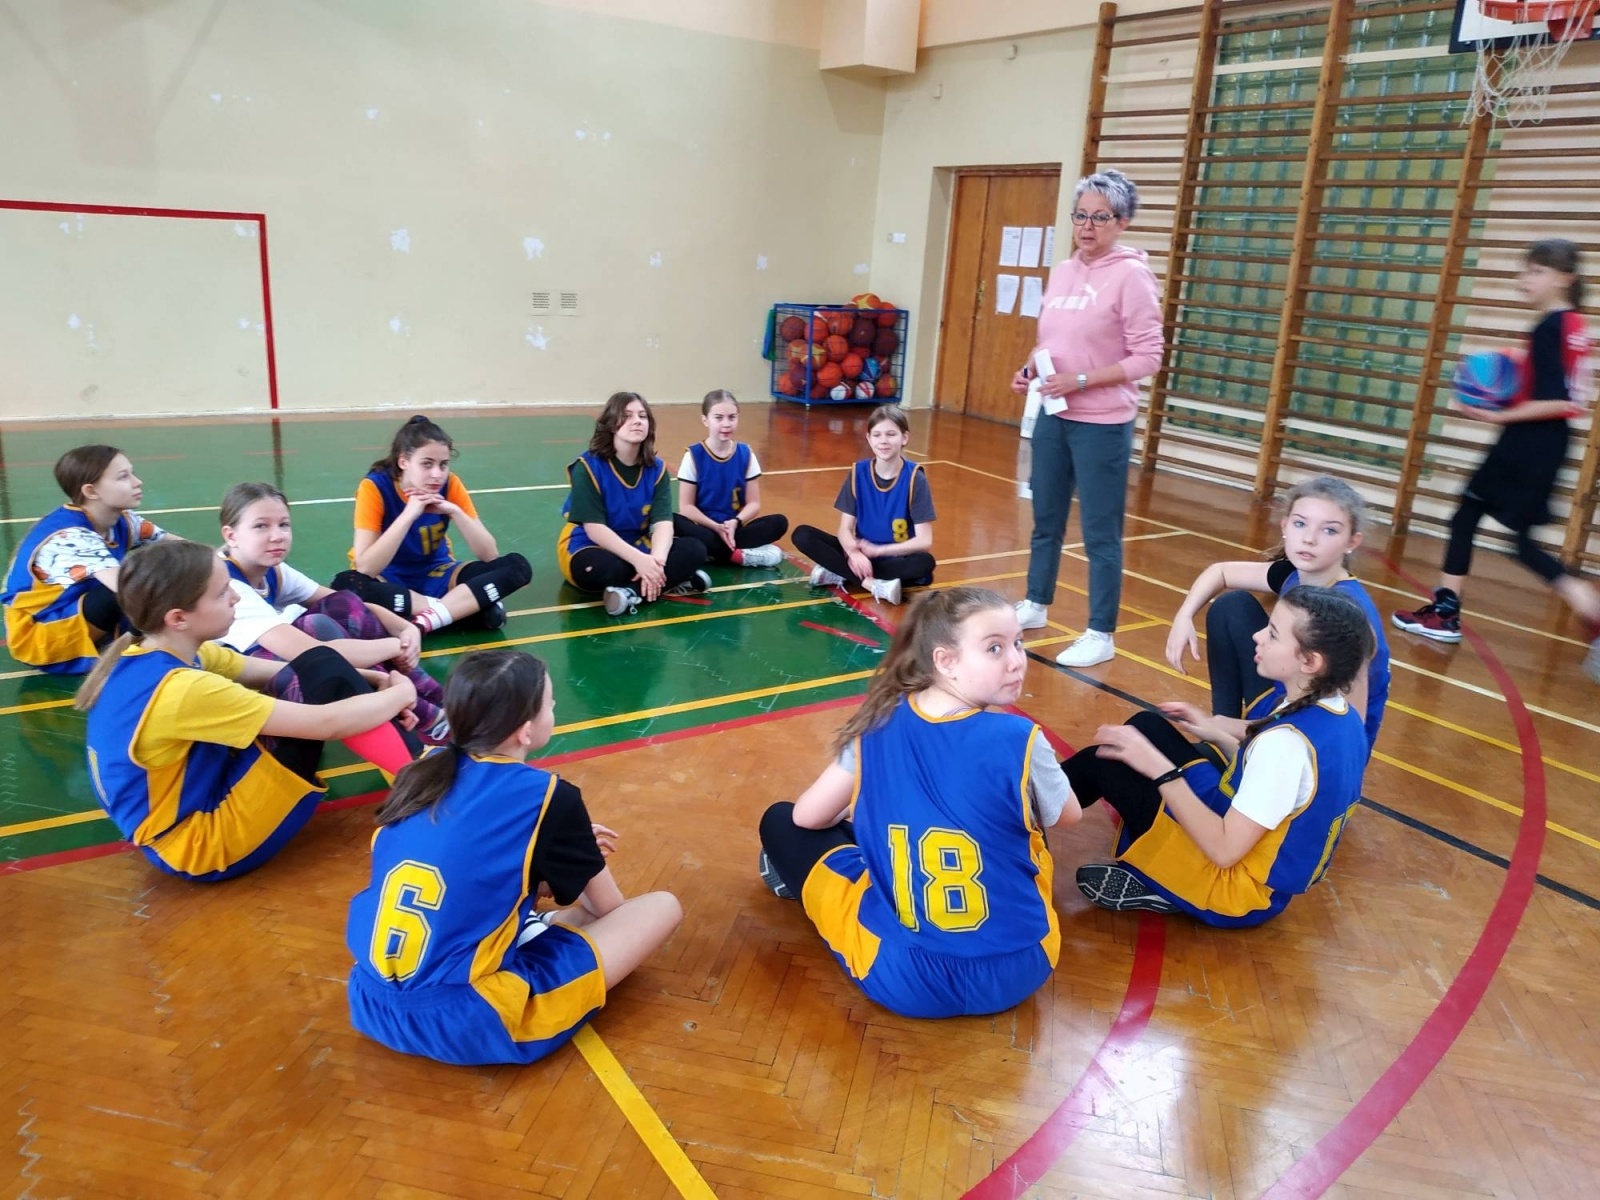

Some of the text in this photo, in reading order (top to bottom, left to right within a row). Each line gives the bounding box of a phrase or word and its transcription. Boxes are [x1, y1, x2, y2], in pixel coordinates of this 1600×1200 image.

[891, 518, 908, 543] 8
[369, 859, 447, 982] 6
[888, 824, 989, 932] 18
